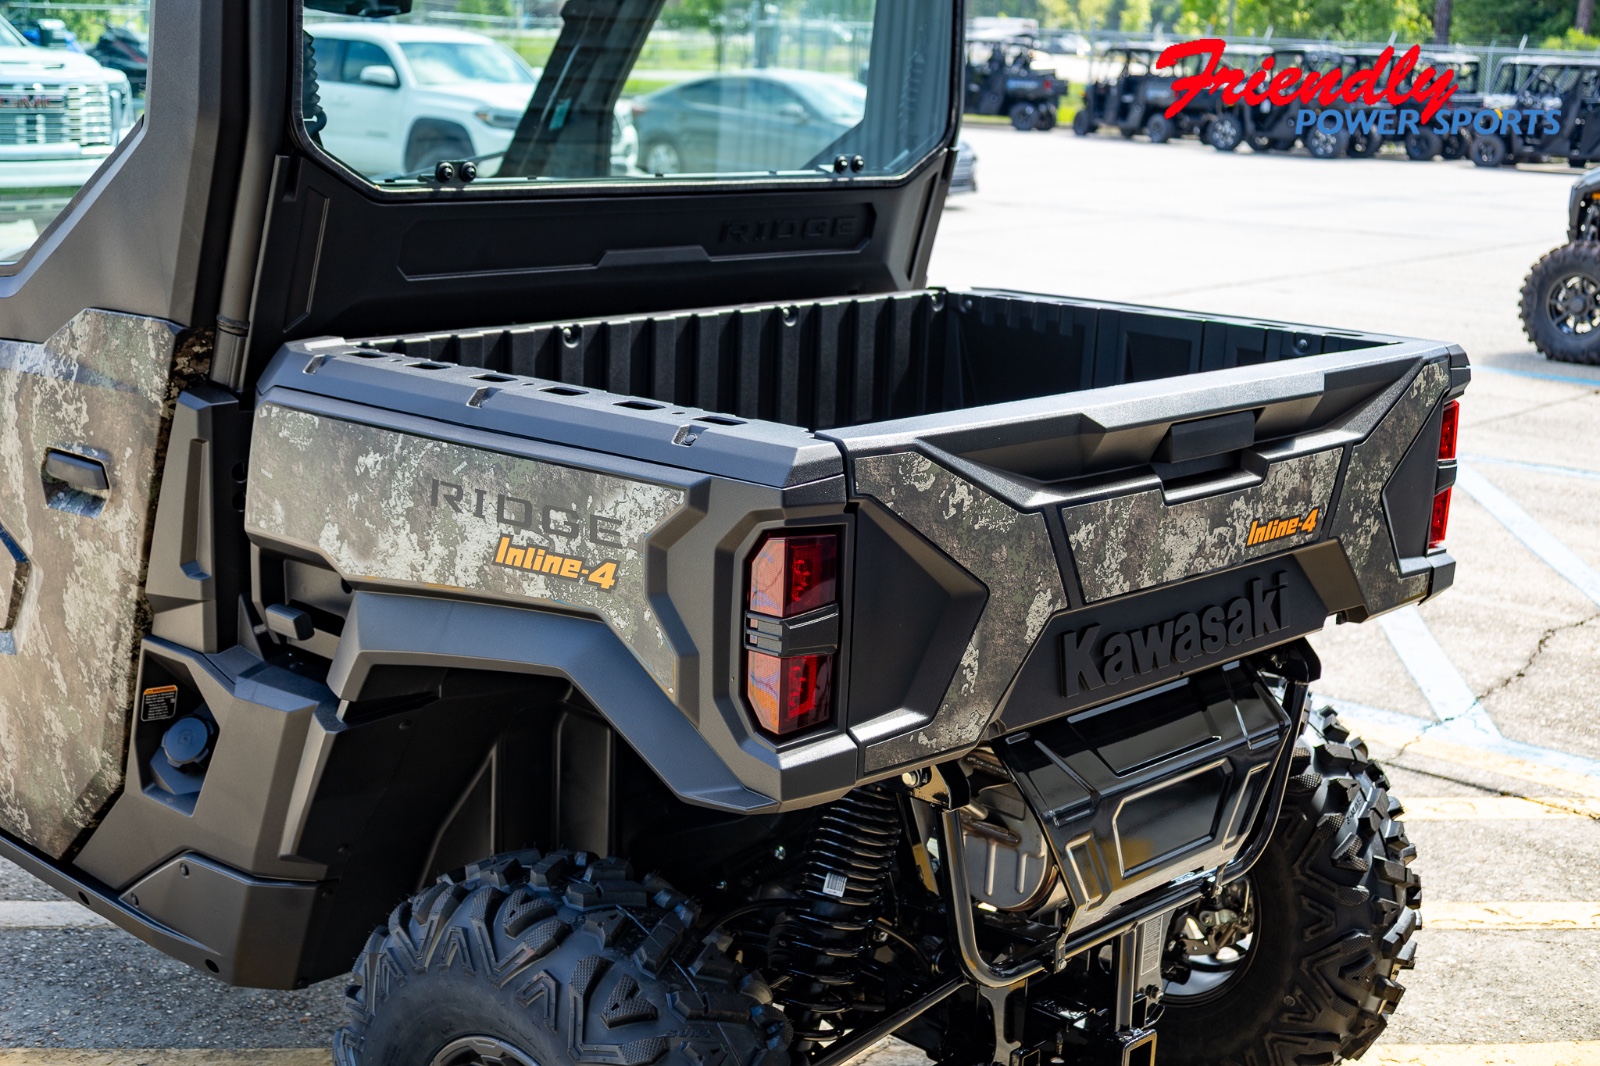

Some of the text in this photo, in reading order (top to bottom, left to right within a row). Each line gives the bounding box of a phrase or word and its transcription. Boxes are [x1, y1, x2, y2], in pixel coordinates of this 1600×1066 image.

[0, 95, 64, 108] GMC
[718, 215, 858, 244] RIDGE
[431, 478, 622, 549] RIDGE
[1246, 508, 1319, 547] Inline-4
[494, 535, 618, 591] Inline-4
[1061, 570, 1291, 698] Kawasaki
